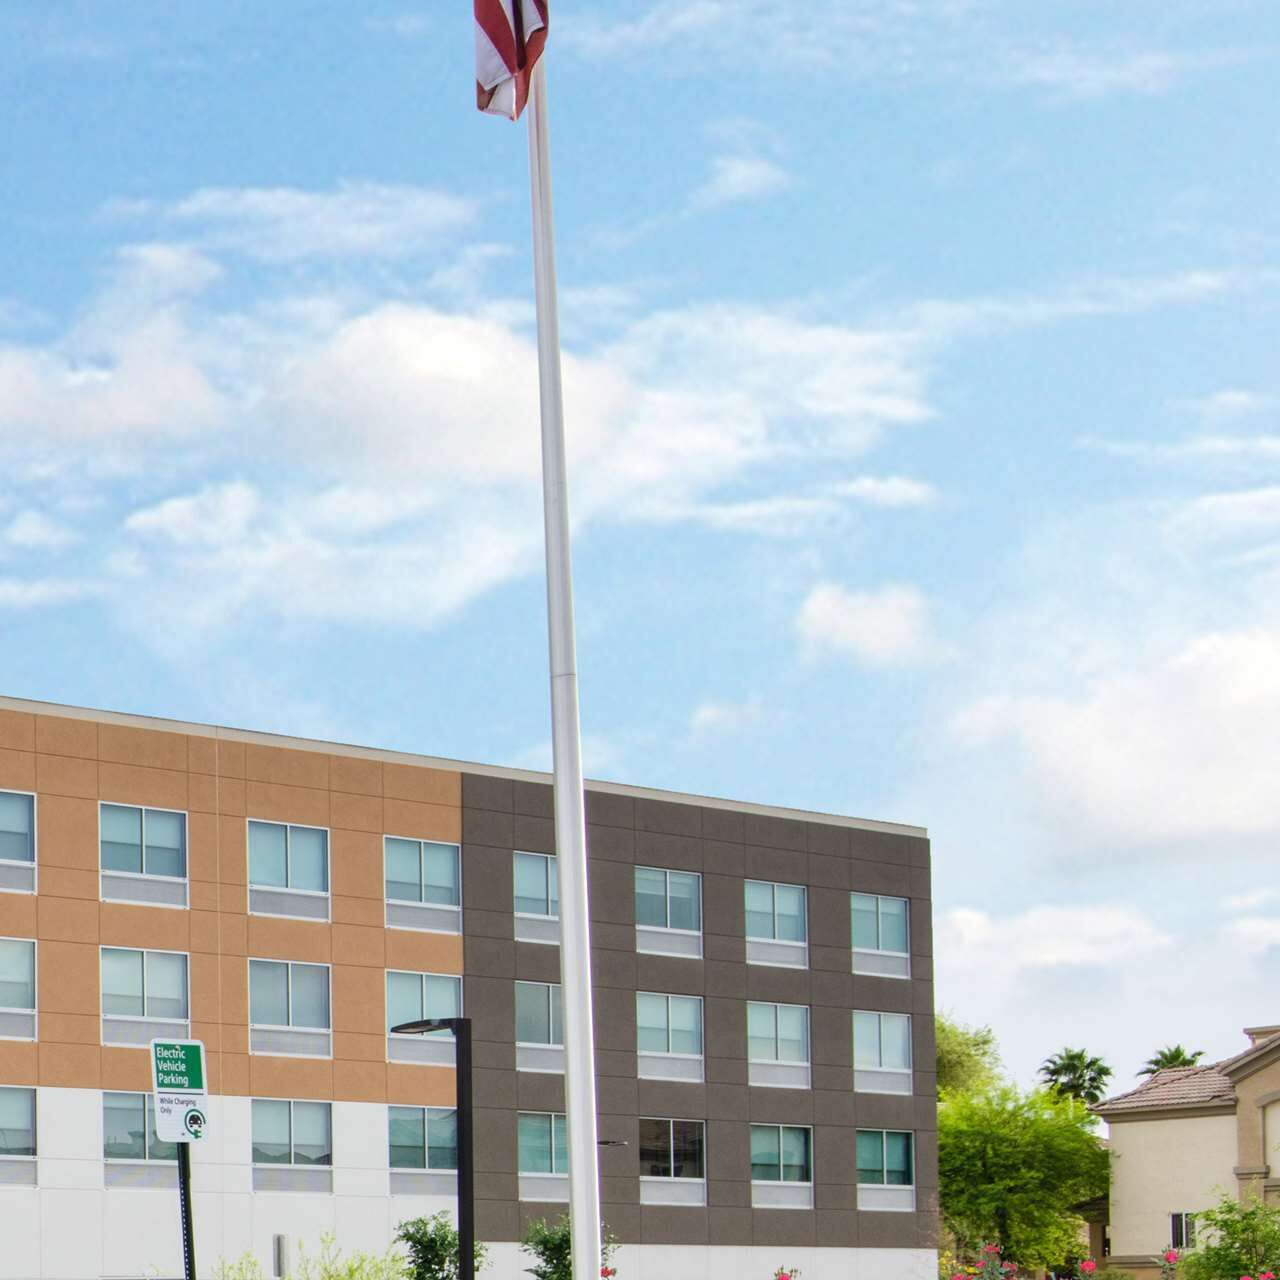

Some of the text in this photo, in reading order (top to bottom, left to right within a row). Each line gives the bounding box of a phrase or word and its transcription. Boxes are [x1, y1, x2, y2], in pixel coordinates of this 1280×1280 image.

[156, 1047, 186, 1059] Electric
[157, 1060, 186, 1072] Vehicle
[159, 1073, 189, 1087] Parking
